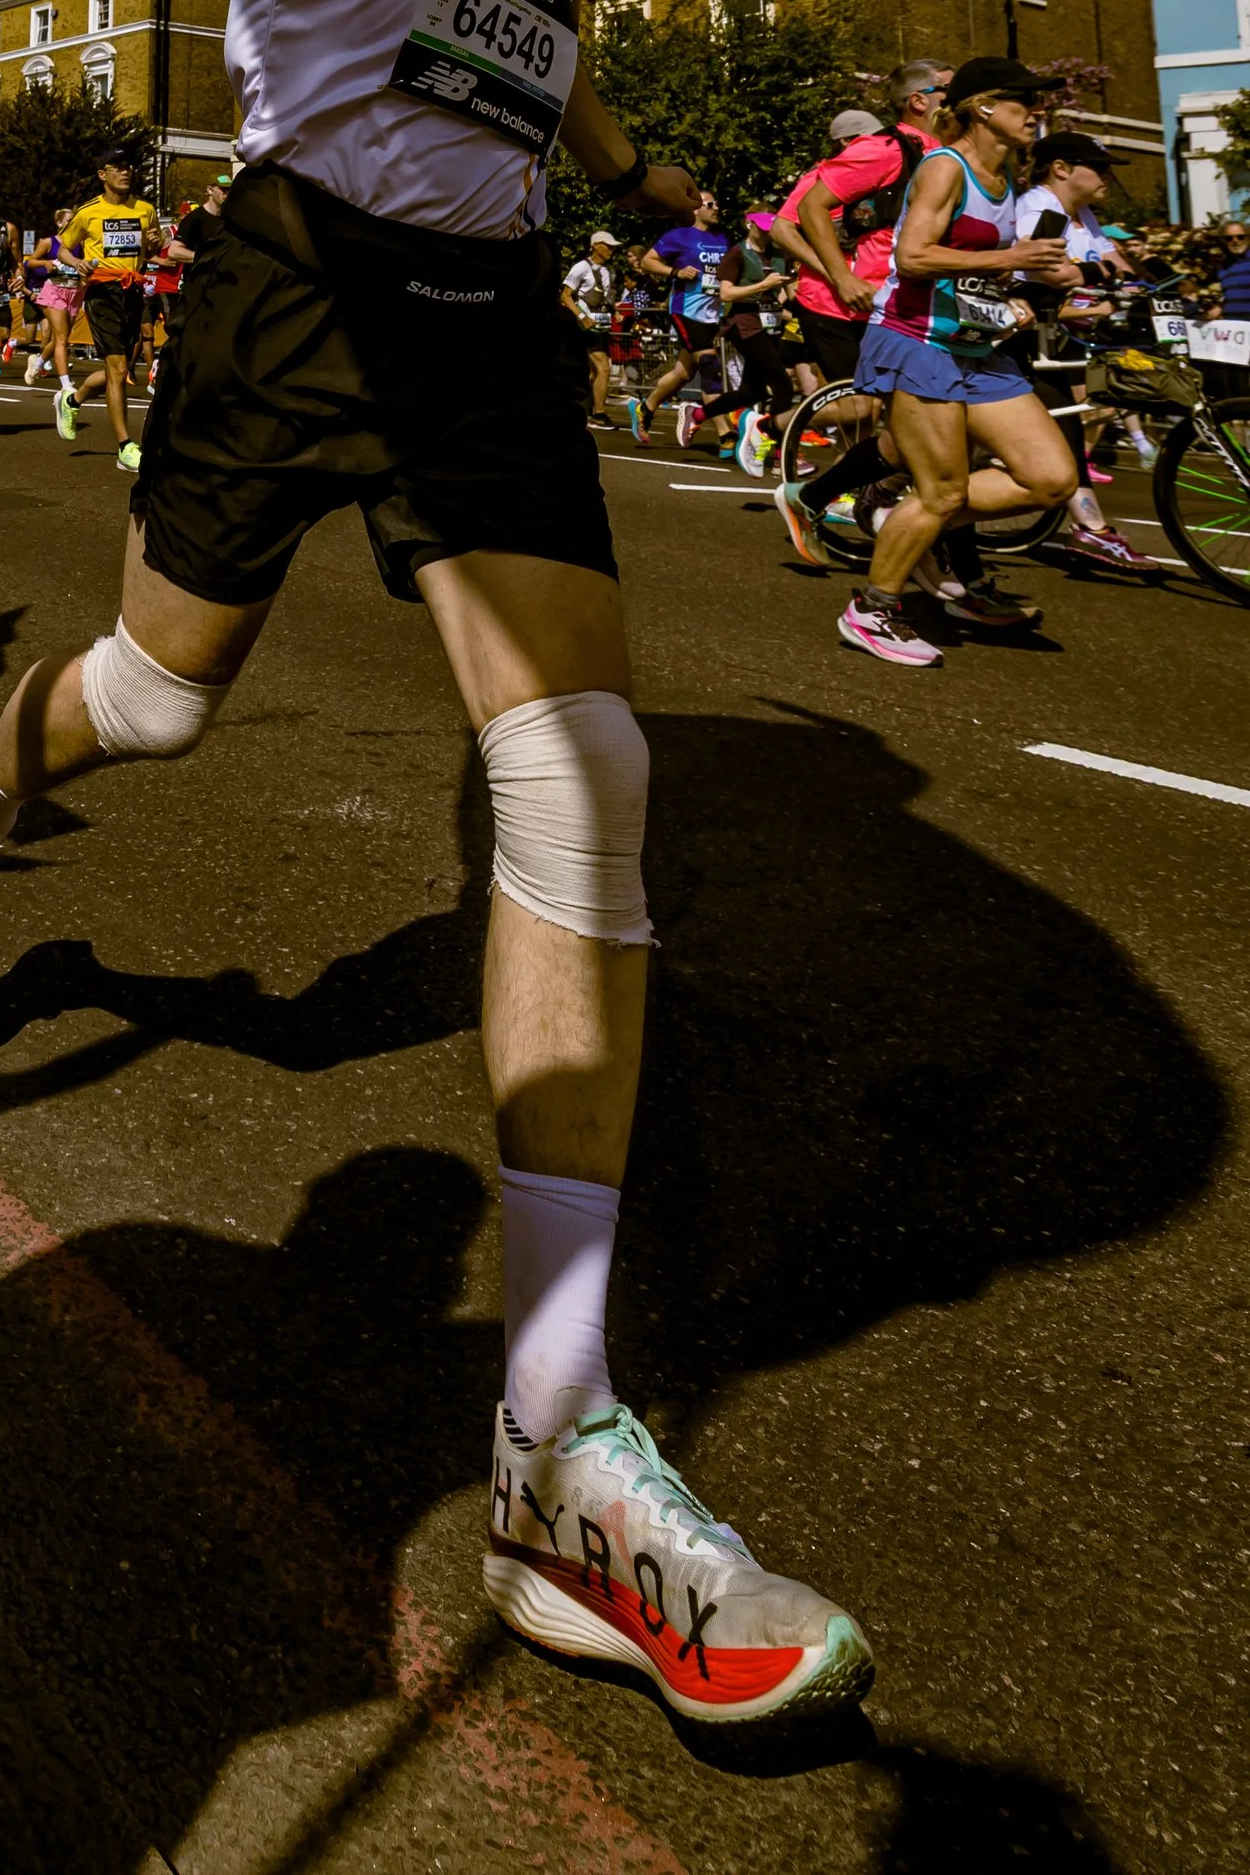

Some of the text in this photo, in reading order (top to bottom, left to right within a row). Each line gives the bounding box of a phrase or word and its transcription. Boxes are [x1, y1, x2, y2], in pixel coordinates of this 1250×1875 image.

[471, 96, 545, 143] new balance
[104, 220, 120, 231] tcs
[109, 234, 136, 245] 72853
[699, 252, 725, 263] CHR
[406, 280, 494, 303] SALOMON
[491, 1456, 718, 1683] HYROX
